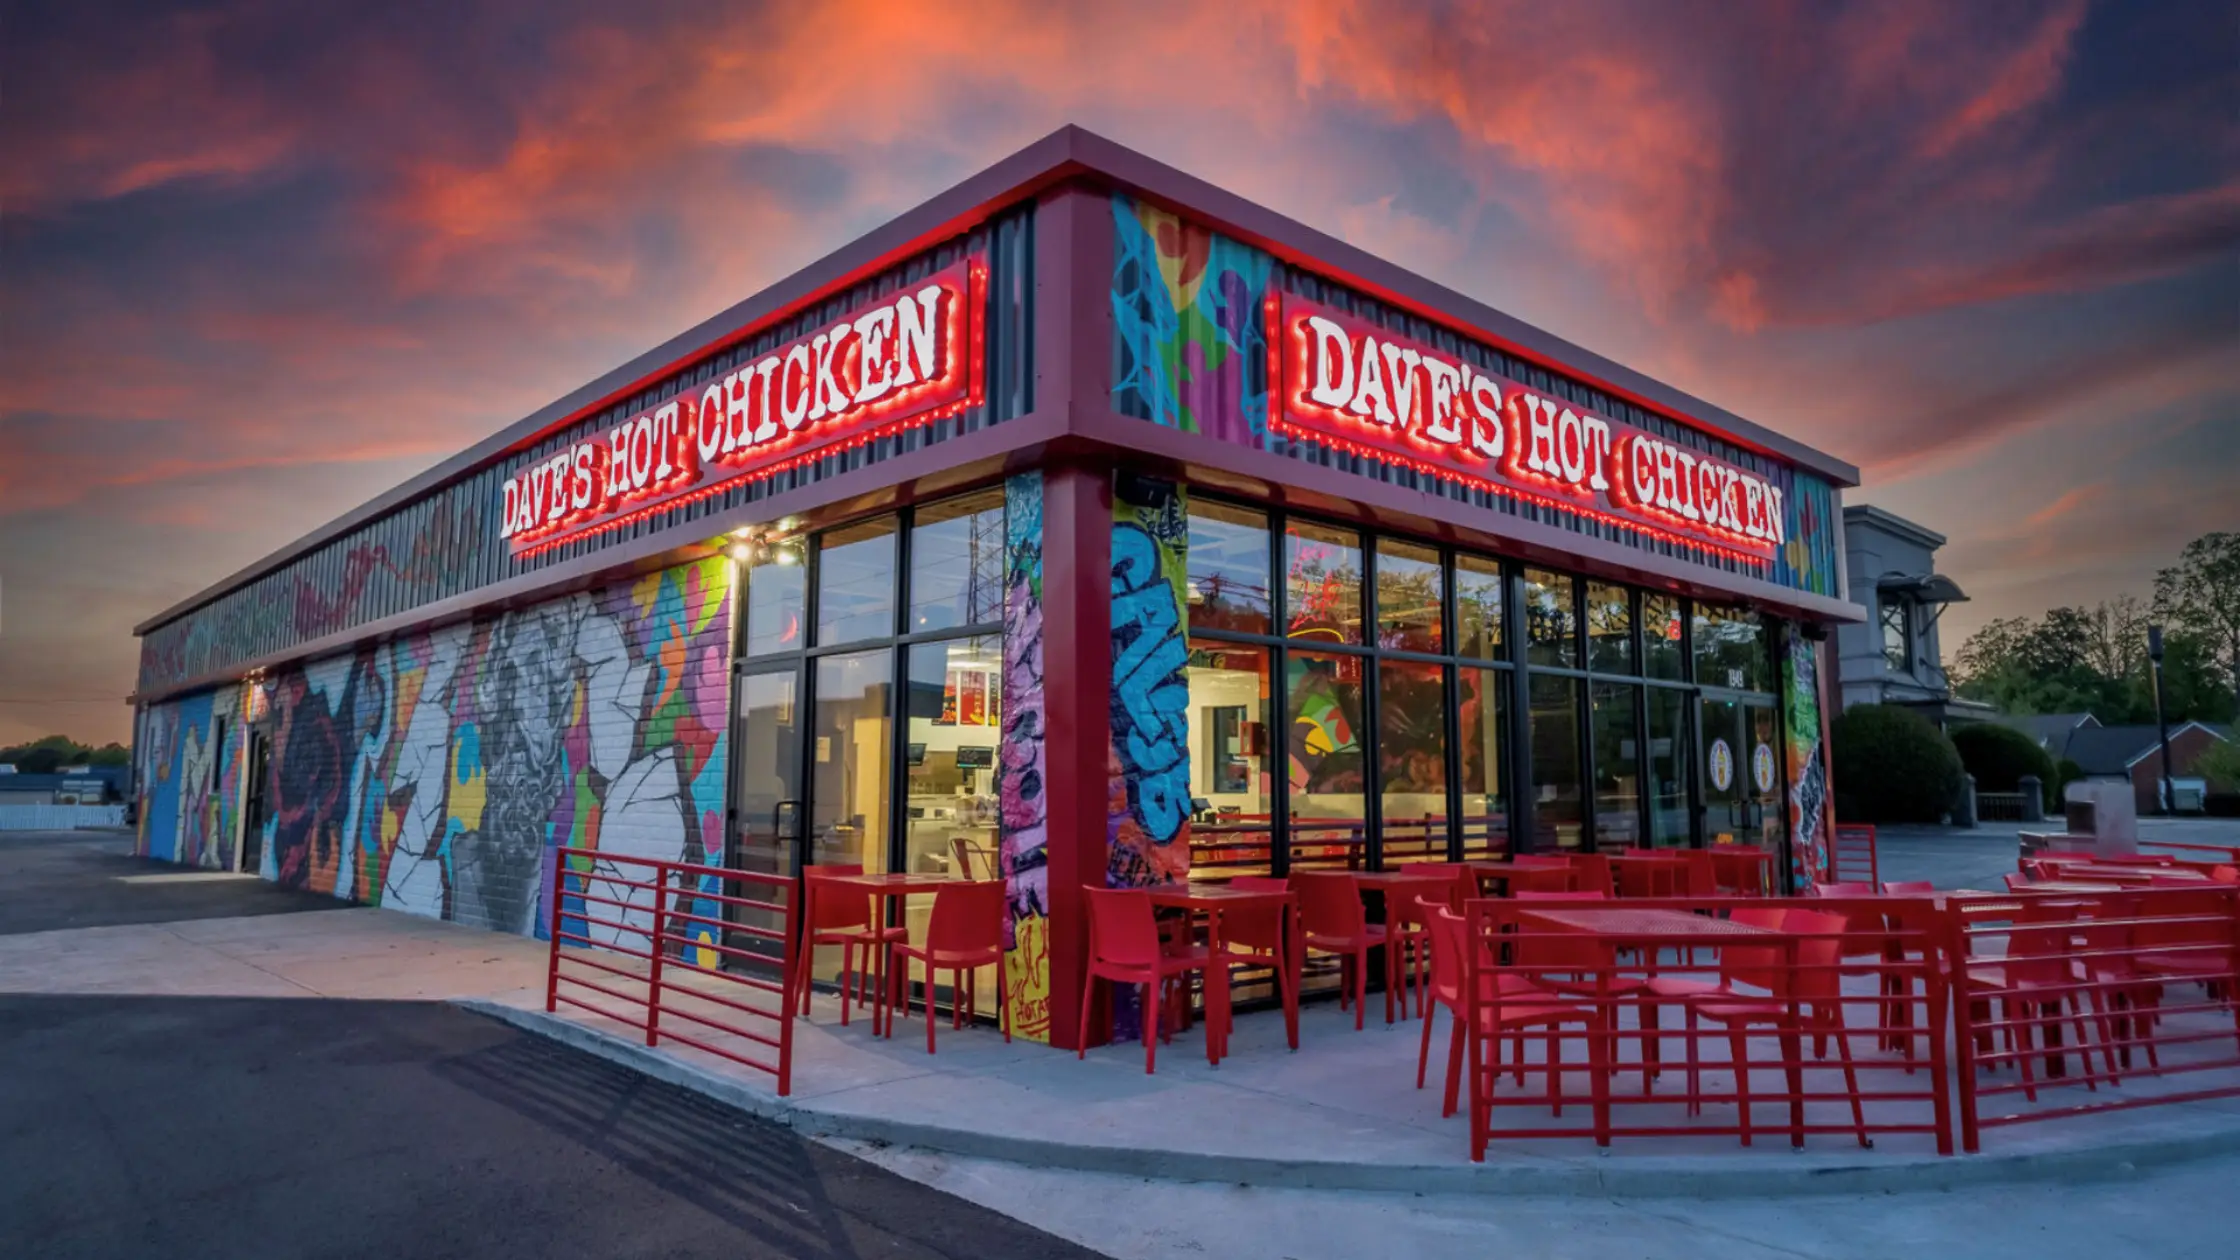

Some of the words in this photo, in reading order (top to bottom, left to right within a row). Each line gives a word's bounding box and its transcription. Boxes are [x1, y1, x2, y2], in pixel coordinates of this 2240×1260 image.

[500, 443, 593, 538] DAVE'S
[607, 401, 680, 497] HOT
[698, 284, 942, 463] CHICKEN
[1309, 316, 1503, 458] DAVE'S
[1524, 394, 1609, 490] HOT
[1632, 434, 1785, 544] CHICKEN
